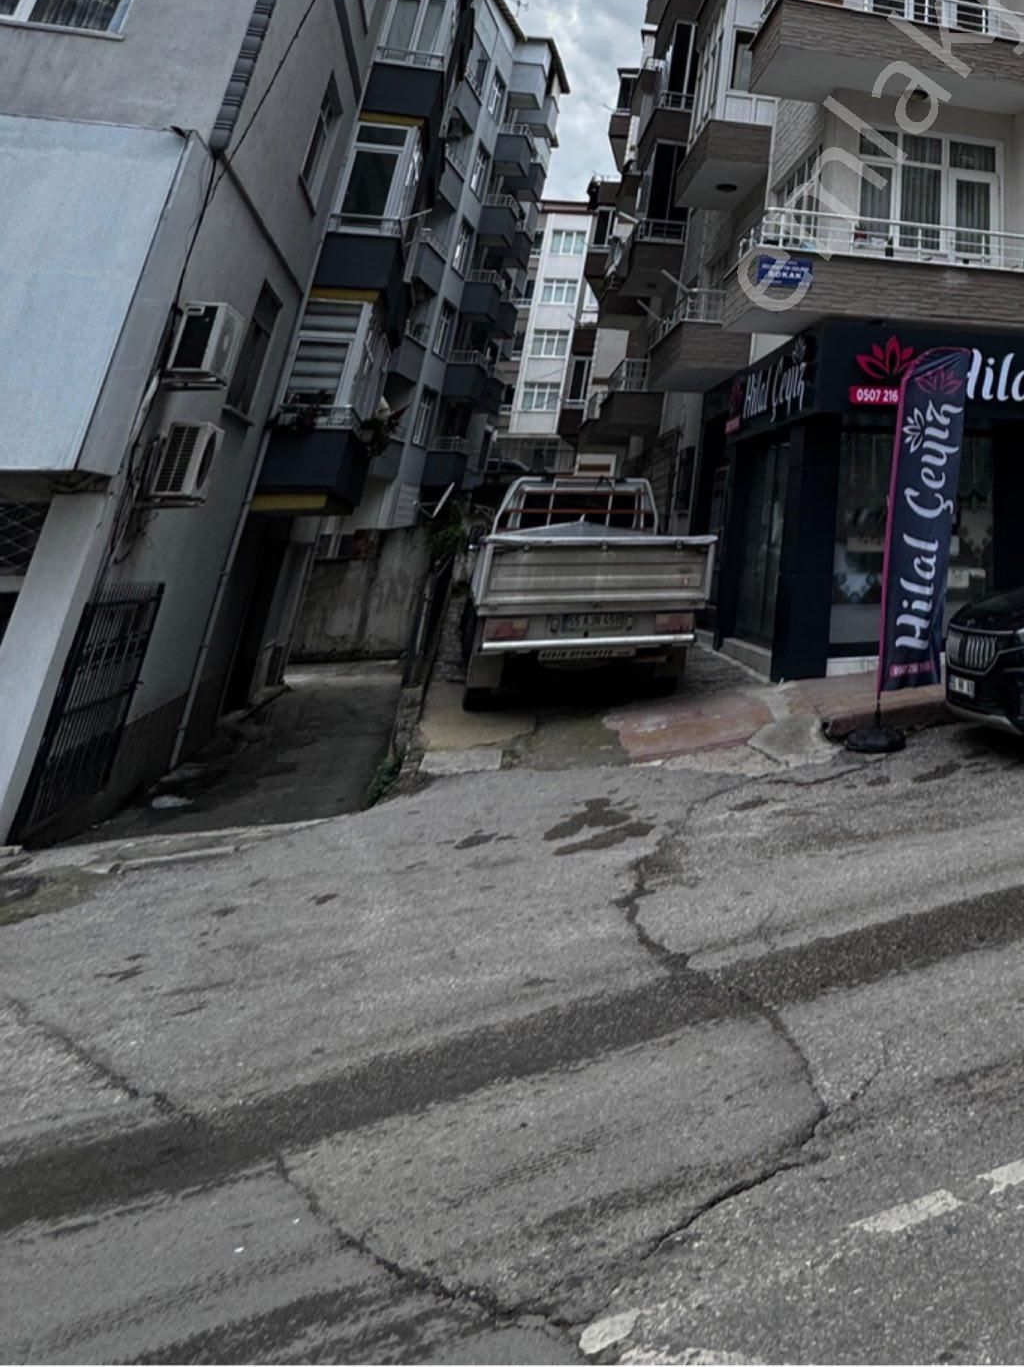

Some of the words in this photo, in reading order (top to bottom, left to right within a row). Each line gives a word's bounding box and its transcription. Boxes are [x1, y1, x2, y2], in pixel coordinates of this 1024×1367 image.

[743, 364, 772, 420] Hilal
[856, 388, 881, 402] 0507
[883, 389, 899, 402] 216
[904, 400, 963, 519] Çeyiz
[896, 533, 939, 650] Hilal
